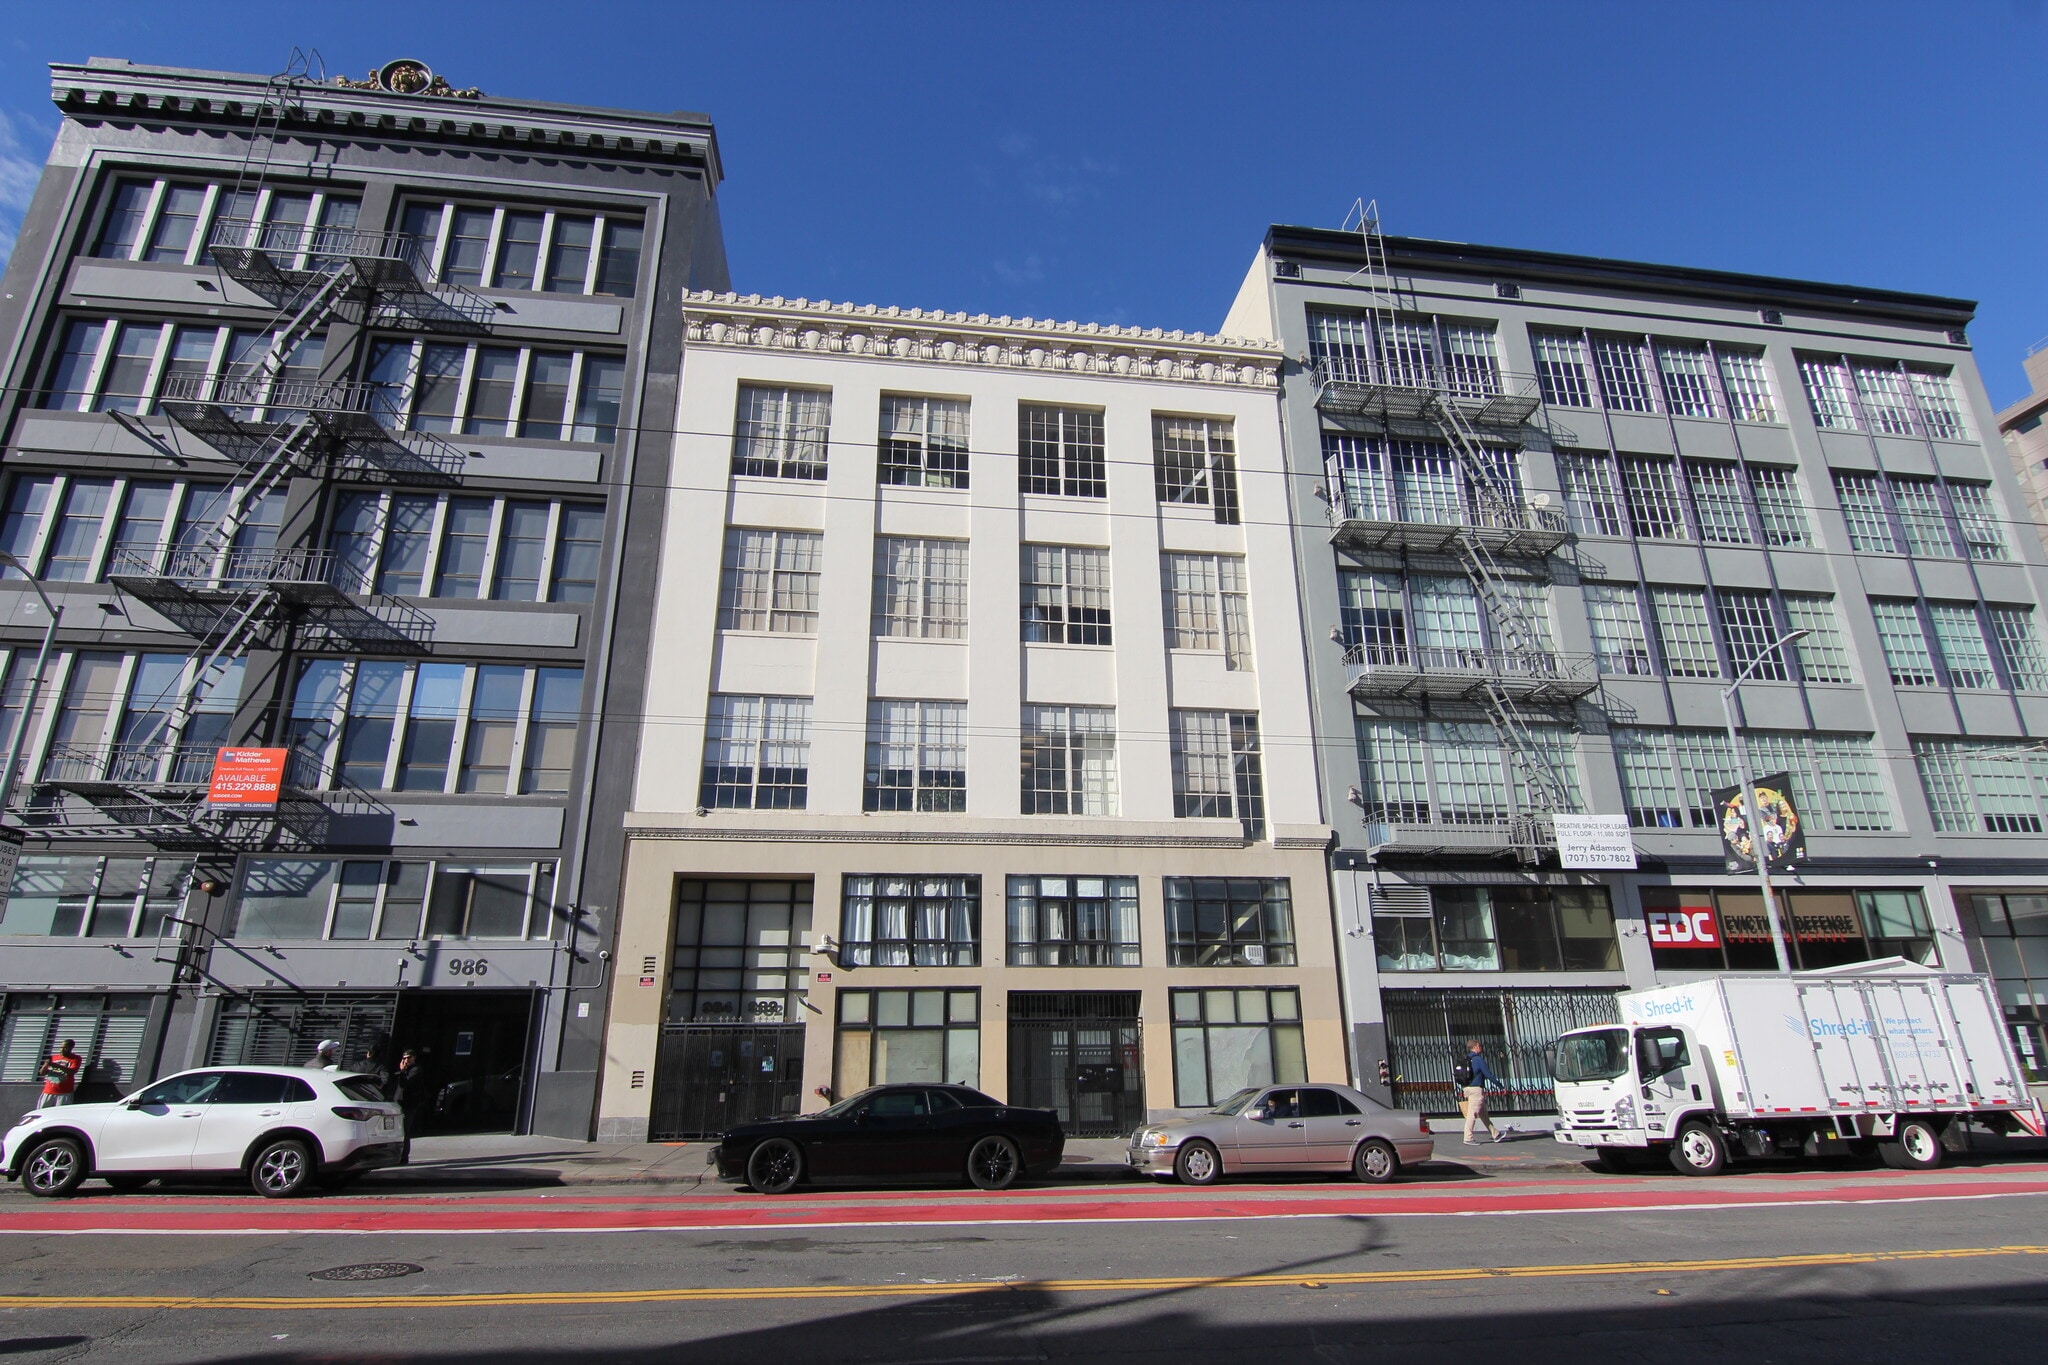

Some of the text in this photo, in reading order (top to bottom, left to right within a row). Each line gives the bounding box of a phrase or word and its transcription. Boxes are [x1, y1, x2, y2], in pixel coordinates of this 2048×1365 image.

[217, 774, 266, 783] AVAILABLE
[215, 783, 277, 791] 415.229.8888
[1567, 844, 1587, 853] Jerry
[1565, 854, 1631, 863] (707) 570-7802
[1648, 913, 1715, 942] EDC
[1724, 915, 1853, 934] EVICTIN DEFENSE
[1728, 932, 1847, 943] COLLAORATIVE
[449, 958, 489, 976] 986
[1645, 996, 1694, 1017] Shred-it
[1810, 1018, 1872, 1035] Shred-it
